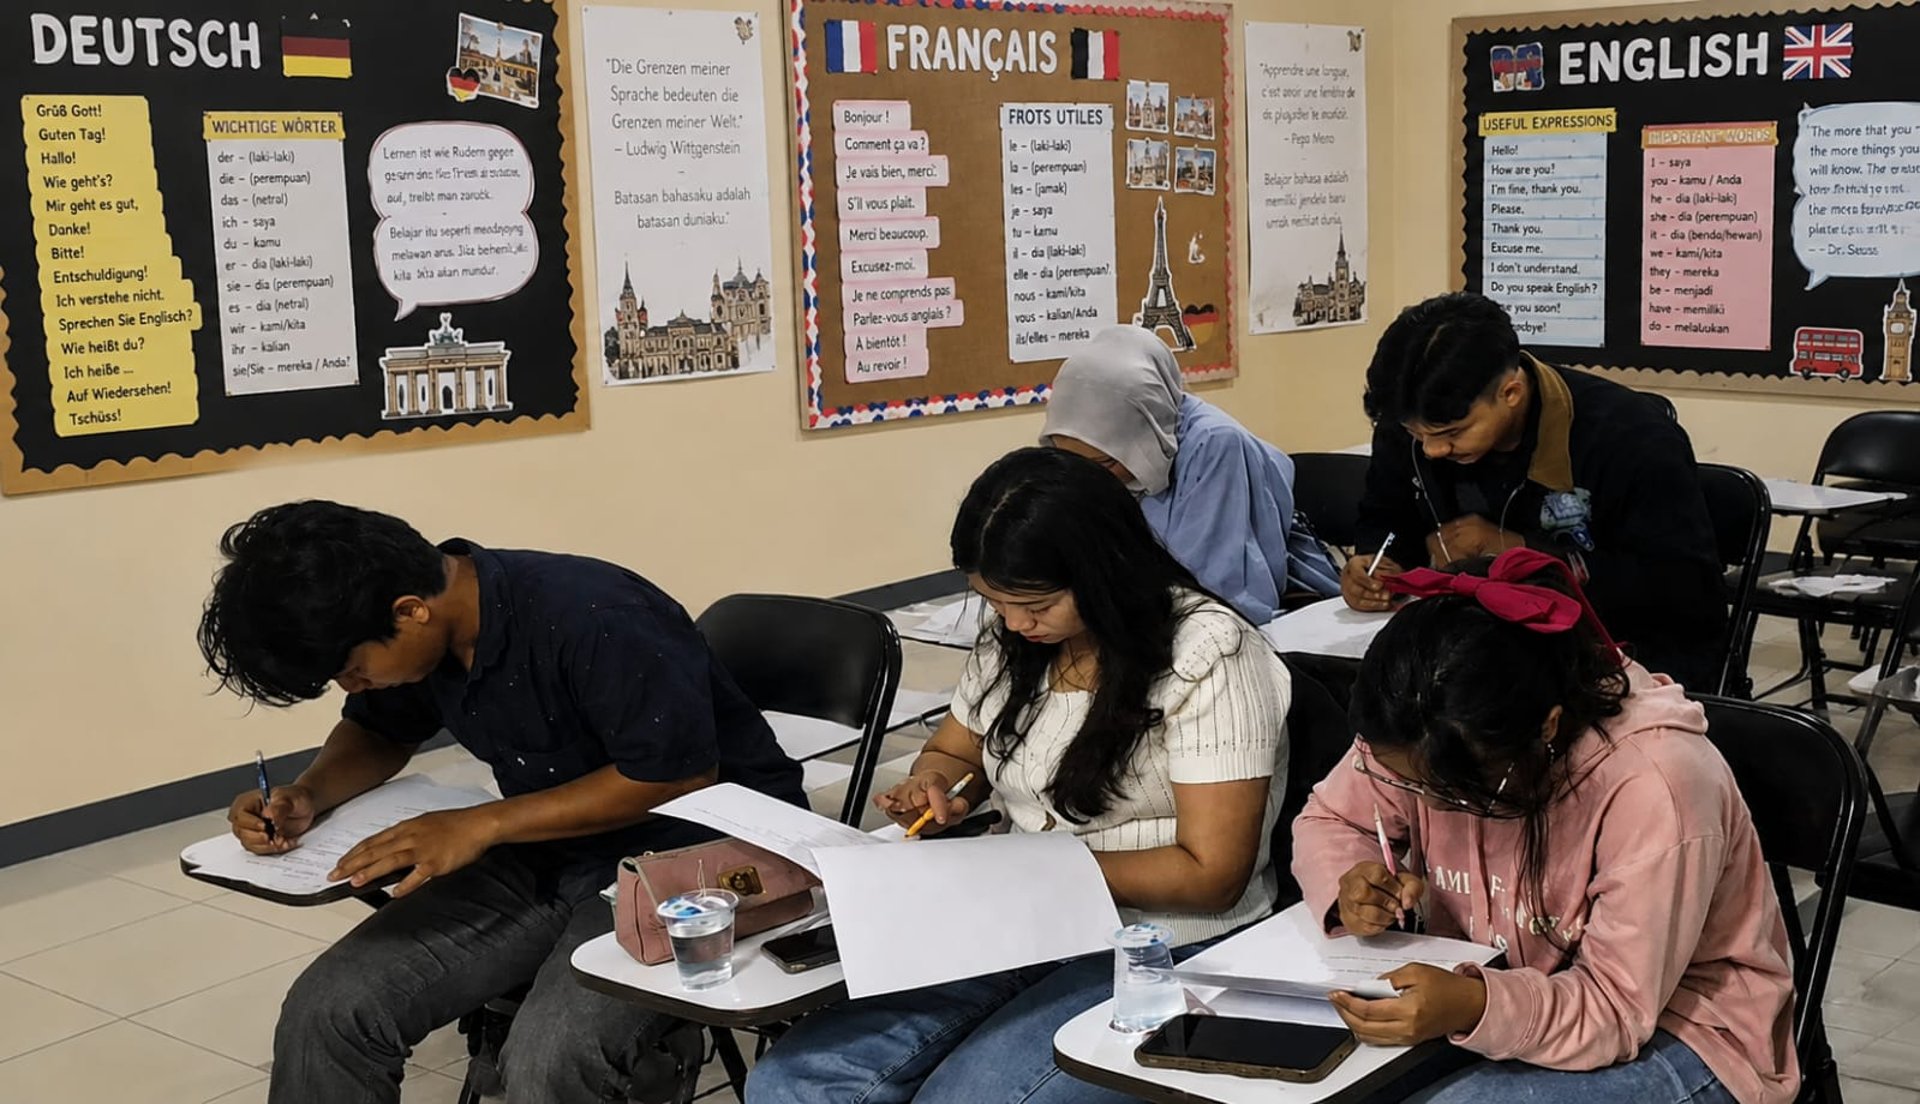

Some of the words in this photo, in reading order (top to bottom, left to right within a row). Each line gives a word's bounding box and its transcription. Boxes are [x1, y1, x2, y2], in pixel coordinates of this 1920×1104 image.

[30, 13, 261, 70] DEUTSCH
[887, 24, 1057, 81] FRANÇAIS
[1559, 31, 1769, 85] ENGLISH
[636, 58, 687, 75] Grenzen
[690, 61, 731, 76] meiner
[610, 84, 659, 106] Sprache
[663, 86, 717, 102] bedeuten
[721, 87, 739, 102] die
[71, 104, 102, 117] Gott!
[1009, 108, 1052, 125] FROTS
[1056, 109, 1103, 125] UTILES
[611, 113, 662, 129] Grenzen
[666, 114, 707, 129] meiner
[844, 110, 883, 127] Bonjour
[1483, 117, 1528, 131] USEFUL
[1532, 114, 1613, 130] EXPRESSIONS
[212, 120, 277, 134] WICHTIGE
[1834, 127, 1862, 137] more
[1865, 124, 1887, 135] that
[1890, 126, 1912, 139] you
[38, 128, 76, 141] Guten
[79, 127, 106, 144] Tag!
[626, 140, 667, 160] Ludwig
[670, 140, 740, 159] Wittgenstein
[845, 137, 891, 151] Comment
[894, 140, 905, 155] ça
[908, 141, 918, 150] va
[1810, 144, 1827, 157] the
[1831, 147, 1858, 156] more
[1861, 144, 1896, 158] things
[41, 151, 76, 164] Hallo!
[217, 151, 234, 163] der
[846, 165, 857, 179] Je
[860, 165, 879, 178] vais
[1491, 164, 1513, 175] How
[1515, 167, 1531, 175] are
[43, 175, 67, 188] Wie
[70, 173, 113, 192] geht's?
[219, 173, 234, 185] die
[249, 171, 311, 187] (perempuan)
[1651, 178, 1668, 188] you
[614, 190, 659, 205] Batasan
[662, 187, 713, 203] bahasaku
[716, 186, 751, 201] adalah
[1531, 183, 1558, 194] thank
[46, 200, 66, 212] Mir
[70, 198, 96, 215] geht
[99, 201, 113, 211] es
[116, 198, 139, 214] gut,
[220, 194, 239, 206] das
[865, 199, 889, 210] vous
[1651, 194, 1662, 204] he
[222, 216, 238, 228] ich
[252, 217, 276, 231] saya
[637, 214, 680, 229] batasan
[1650, 212, 1667, 222] she
[48, 222, 91, 237] Danke!
[849, 228, 877, 241] Merci
[1491, 222, 1520, 234] Thank
[223, 238, 237, 250] du
[253, 237, 281, 248] kamu
[1491, 241, 1523, 254] Excuse
[51, 245, 84, 260] Bitte!
[225, 262, 236, 271] er
[251, 258, 267, 270] dia
[53, 265, 148, 284] Entschuldigung!
[1649, 266, 1671, 279] they
[226, 283, 241, 292] sie
[255, 279, 270, 291] dia
[273, 274, 334, 292] (perempuan)
[1491, 281, 1504, 292] Do
[1507, 284, 1524, 295] you
[1526, 283, 1554, 295] speak
[56, 294, 76, 308] Ich
[79, 291, 129, 305] verstehe
[132, 288, 164, 302] nicht.
[852, 289, 863, 303] Je
[866, 291, 878, 301] ne
[880, 285, 932, 304] comprends
[228, 304, 240, 313] es
[256, 300, 272, 312] dia
[1514, 305, 1532, 315] you
[58, 316, 115, 334] Sprechen
[118, 313, 136, 327] Sie
[139, 308, 193, 327] Englisch?
[853, 312, 909, 326] Parlez-vous
[911, 307, 944, 324] anglais
[230, 323, 246, 334] wir
[60, 342, 85, 355] Wie
[88, 339, 120, 353] heißt
[123, 336, 145, 351] du?
[64, 365, 84, 379] Ich
[857, 360, 870, 373] Au
[873, 358, 901, 372] revoir
[67, 388, 88, 403] Auf
[91, 381, 171, 400] Wiedersehen!
[69, 408, 121, 426] Tschüss!
